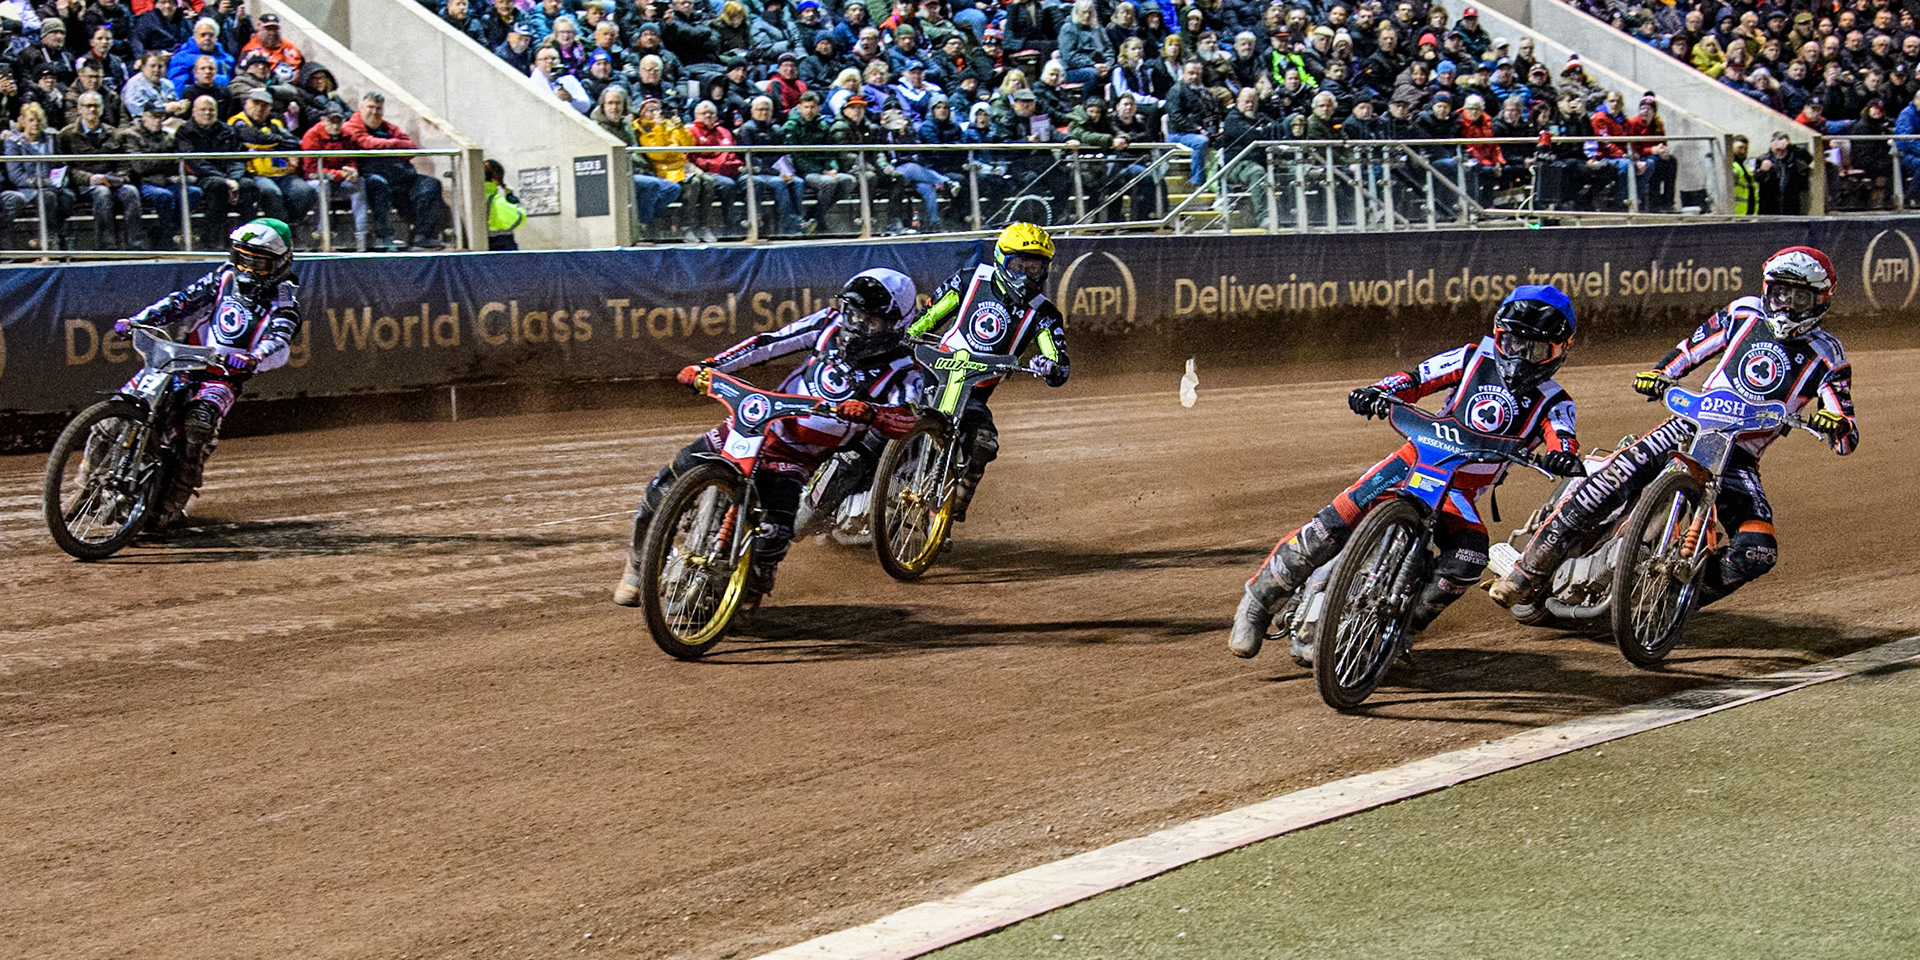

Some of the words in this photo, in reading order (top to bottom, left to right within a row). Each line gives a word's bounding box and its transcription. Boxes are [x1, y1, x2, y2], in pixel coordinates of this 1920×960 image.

[1871, 258, 1909, 283] ATPI
[1348, 268, 1435, 306] world
[1444, 267, 1518, 301] class
[1620, 260, 1743, 296] solutions
[1011, 305, 1025, 319] 14
[1072, 285, 1122, 315] ATPI
[326, 302, 460, 350] World
[478, 300, 593, 345] Class
[606, 294, 737, 340] Travel
[1747, 350, 1765, 358] BELLE
[1773, 345, 1791, 371] CRAVEN
[1794, 353, 1805, 365] 8
[1474, 394, 1494, 403] BELLE
[1733, 377, 1765, 400] MEMORIAL
[1501, 388, 1519, 415] CRAVEN
[1521, 396, 1531, 408] 3
[1712, 398, 1747, 417] PSH
[1576, 454, 1638, 513] HANSEN
[1630, 447, 1650, 465] &
